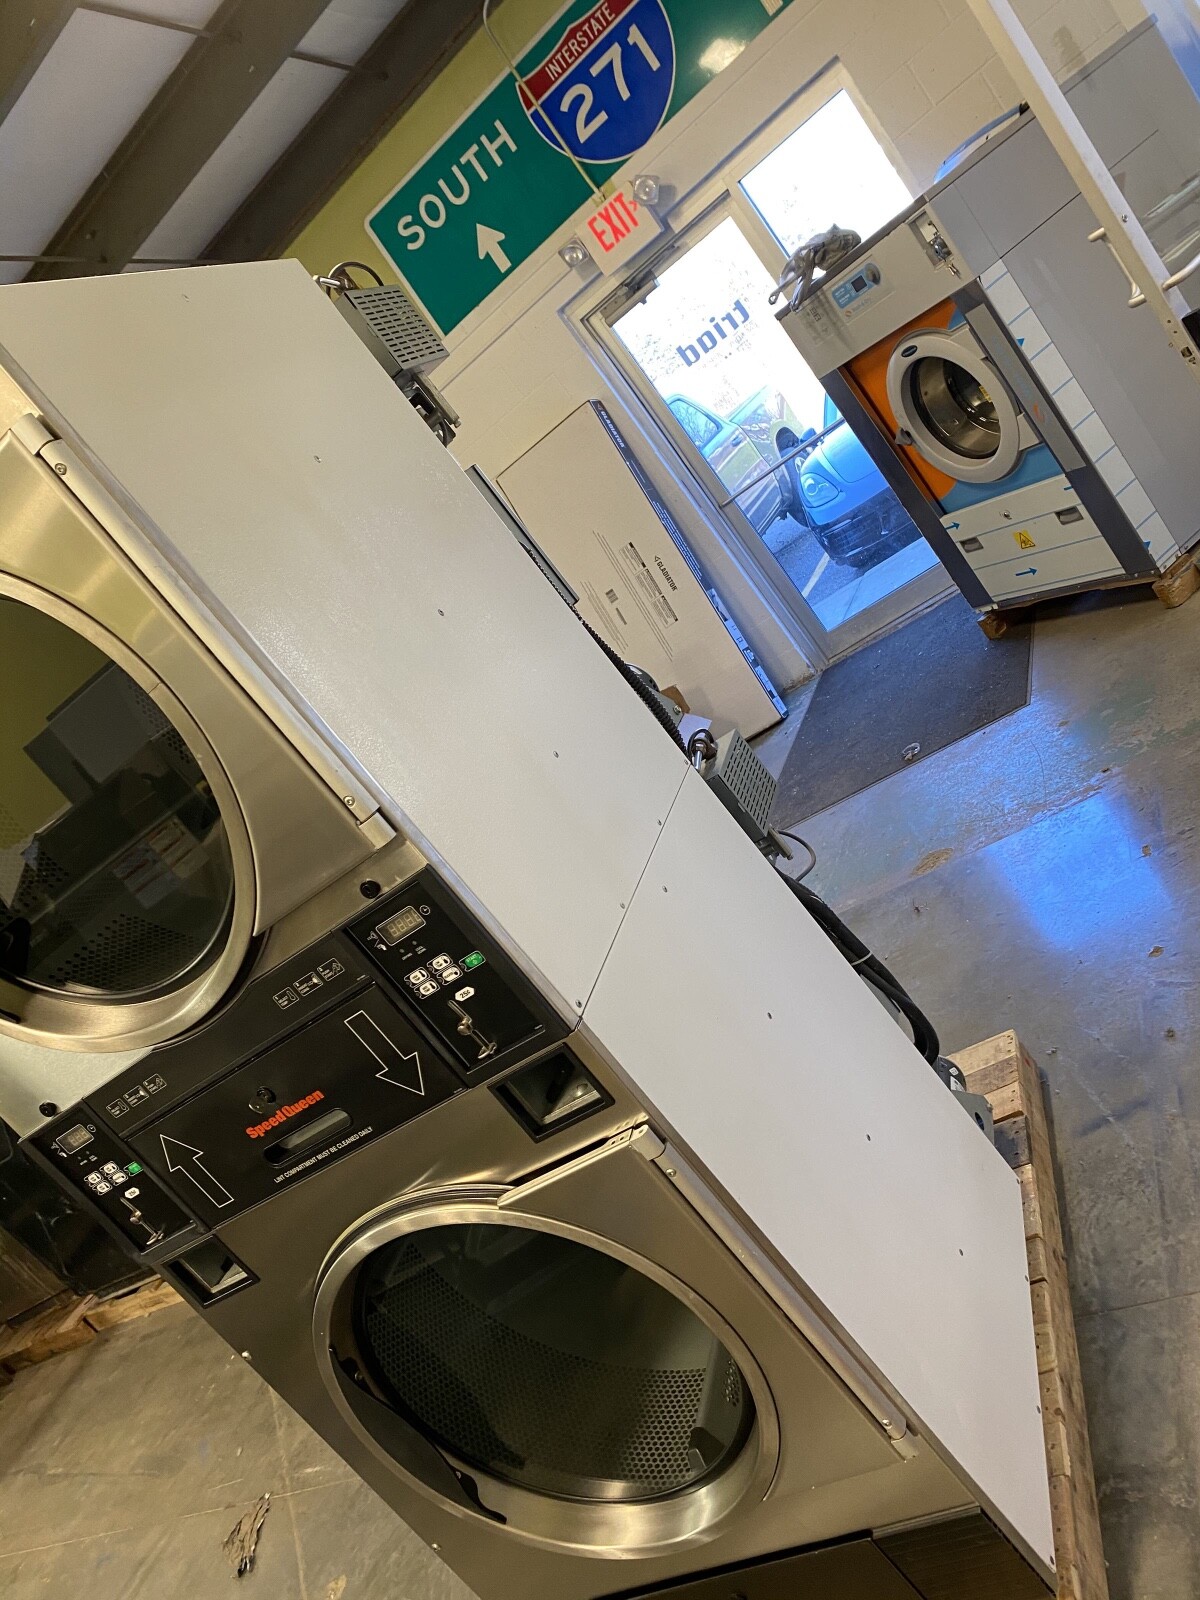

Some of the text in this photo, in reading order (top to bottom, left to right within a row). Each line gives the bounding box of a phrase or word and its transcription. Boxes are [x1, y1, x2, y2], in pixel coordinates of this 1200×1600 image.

[545, 4, 616, 82] INTERSTATE
[560, 23, 662, 145] 271
[396, 118, 518, 251] SOUTH
[587, 192, 640, 253] EXIT
[656, 560, 678, 592] GLADIATOR
[274, 1174, 285, 1183] LINT
[284, 1157, 318, 1178] COMPARTMENT
[317, 1150, 331, 1161] MUST
[337, 1133, 360, 1149] CLEANED
[359, 1126, 373, 1138] DAILY
